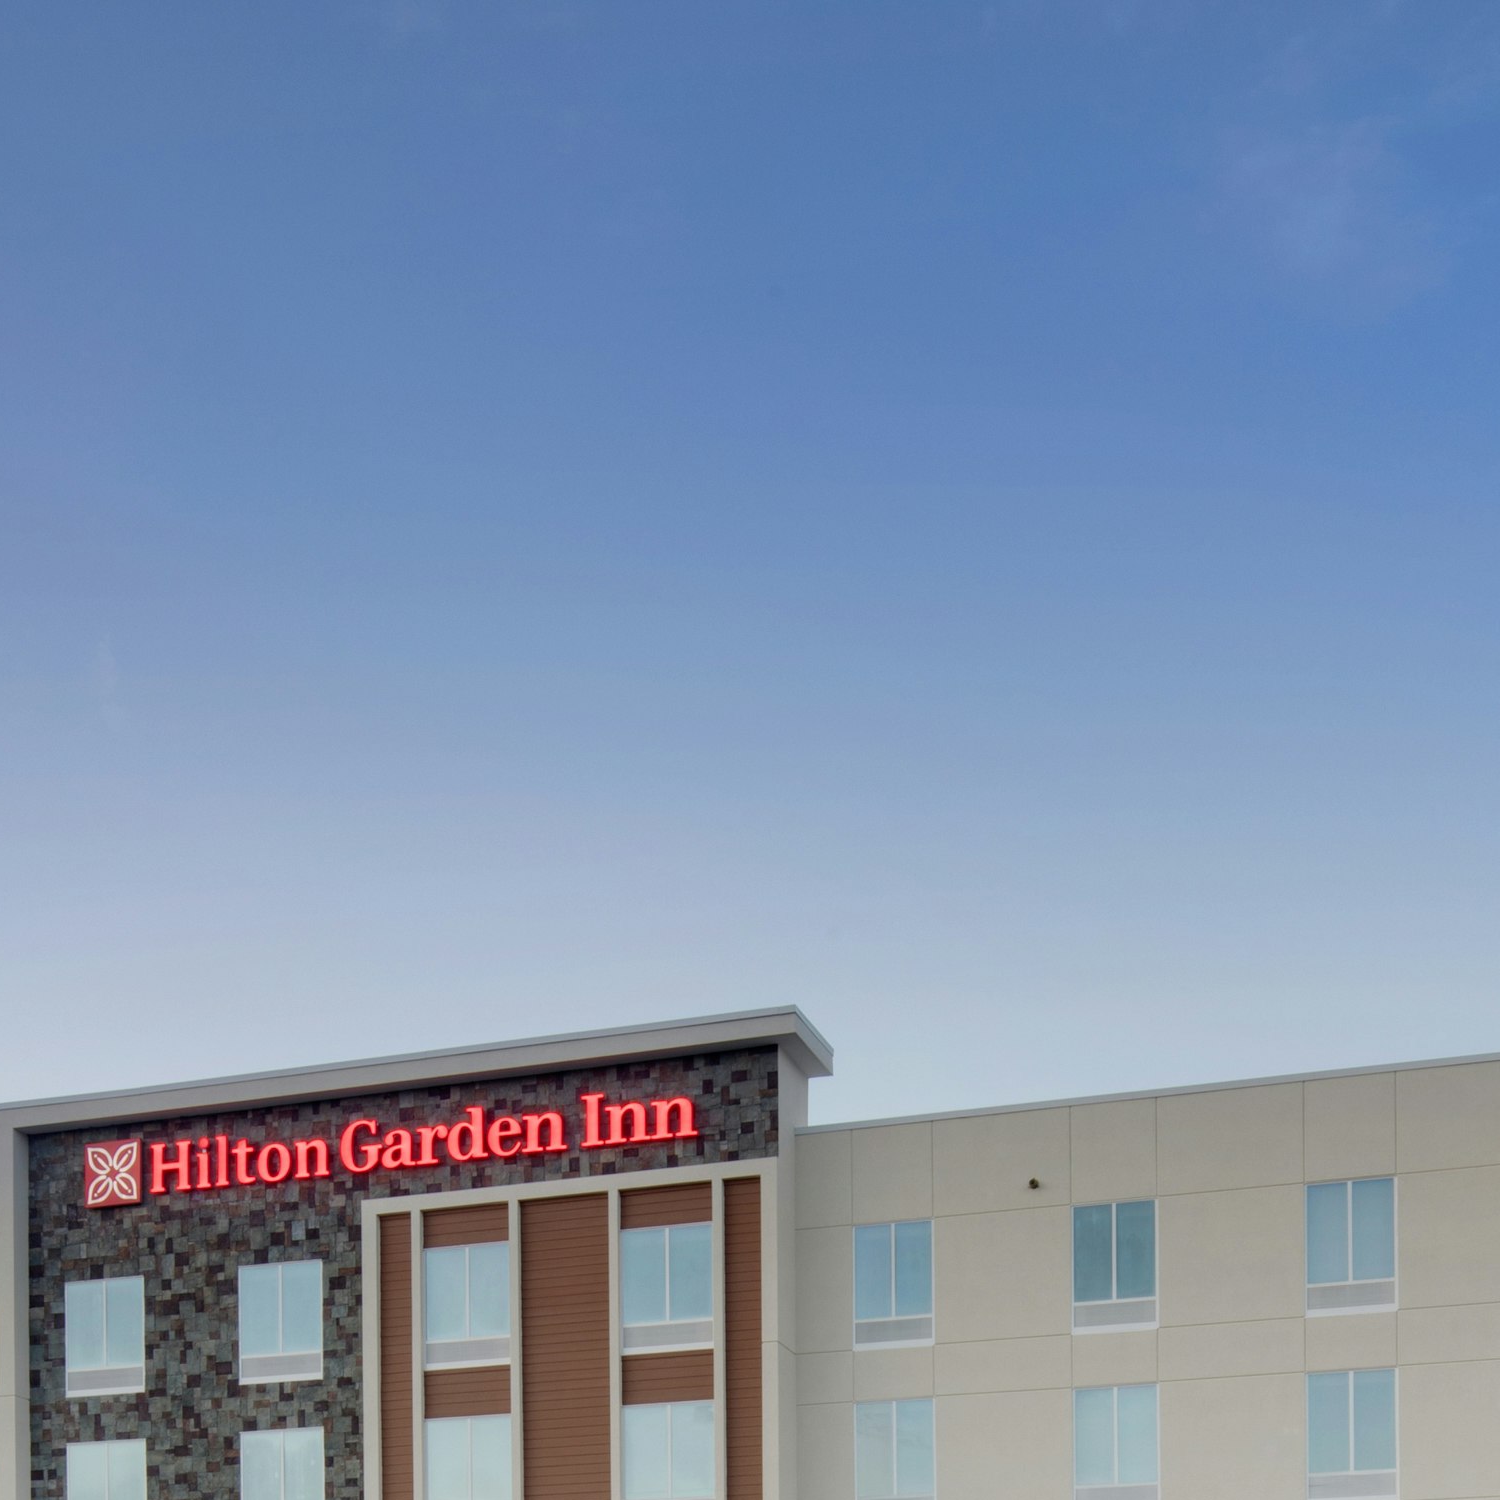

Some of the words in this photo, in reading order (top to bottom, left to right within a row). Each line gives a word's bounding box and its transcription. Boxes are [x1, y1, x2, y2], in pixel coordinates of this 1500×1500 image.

[149, 1134, 330, 1193] Hilton
[339, 1106, 568, 1173] Garden
[580, 1093, 698, 1147] Inn
